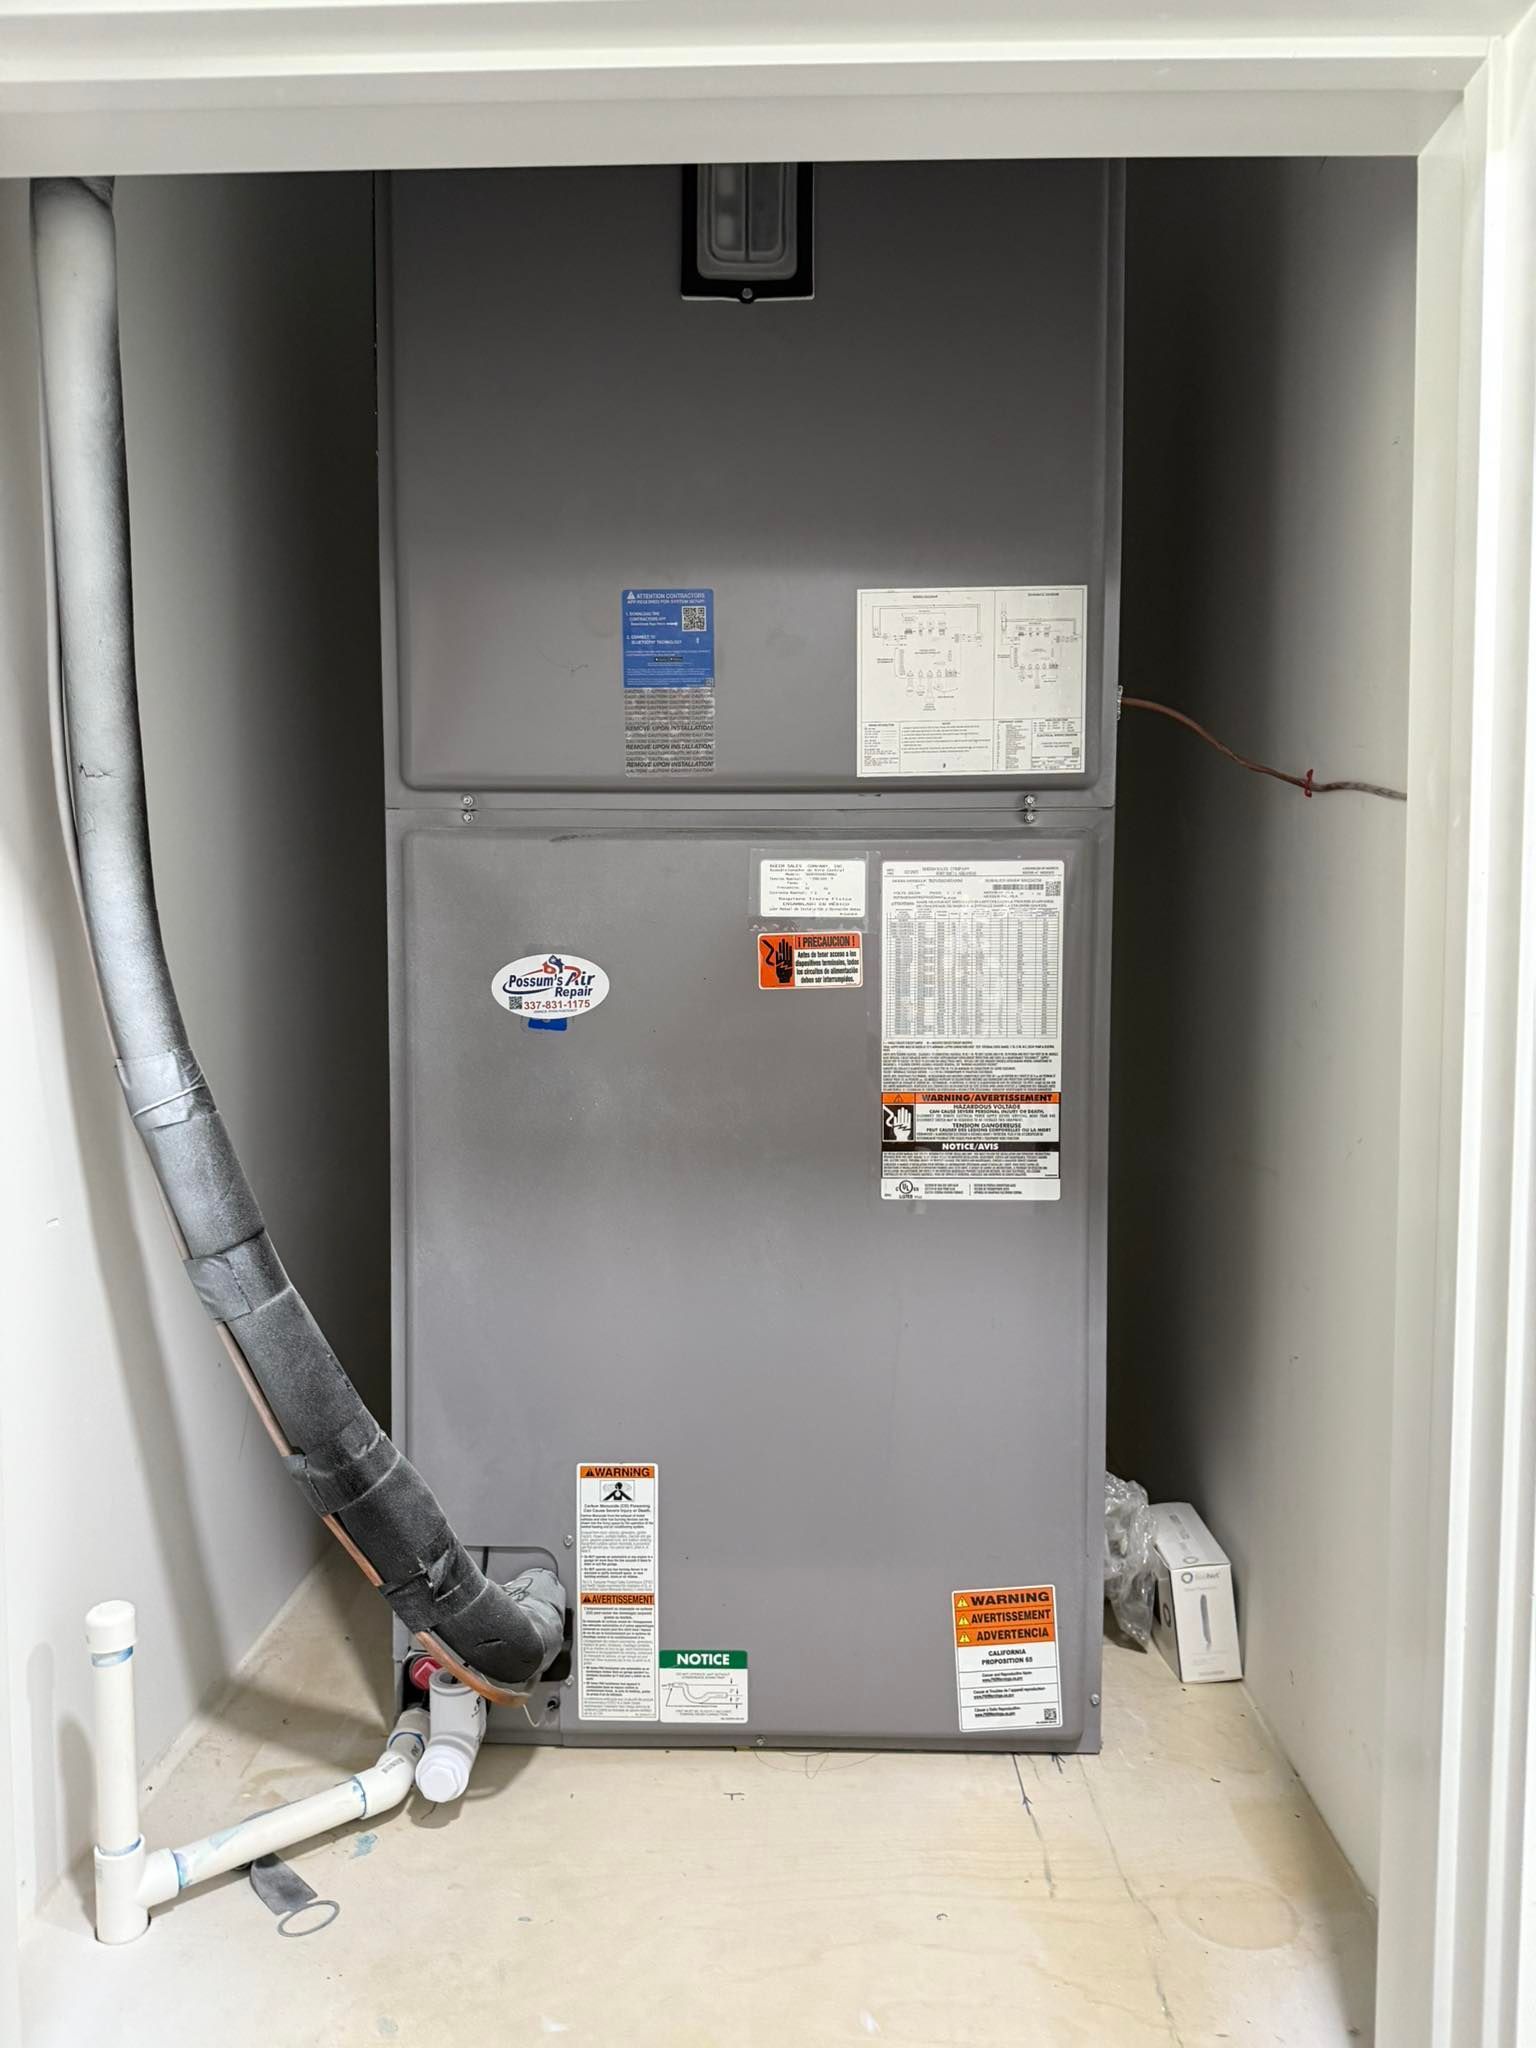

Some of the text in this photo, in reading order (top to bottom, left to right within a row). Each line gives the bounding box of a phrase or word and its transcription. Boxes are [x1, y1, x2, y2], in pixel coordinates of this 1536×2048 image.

[803, 936, 850, 947] PRECAUCION
[509, 971, 595, 987] Possum's Air
[555, 986, 593, 999] Repair
[524, 1000, 591, 1010] 337-831-1175
[922, 1094, 1052, 1102] WARNING/AVERTISSEMENT
[942, 1143, 999, 1151] NOTICE/AVIS
[595, 1468, 650, 1477] WARNING
[592, 1595, 653, 1604] AVERTISSEMENT
[970, 1592, 1050, 1606] WARNING
[971, 1609, 1051, 1624] AVERTISSEMENT
[976, 1627, 1049, 1641] ADVERTENCIA
[988, 1649, 1026, 1657] CALIFORNIA
[677, 1653, 730, 1666] NOTICE
[981, 1657, 1024, 1665] PROPOSITION
